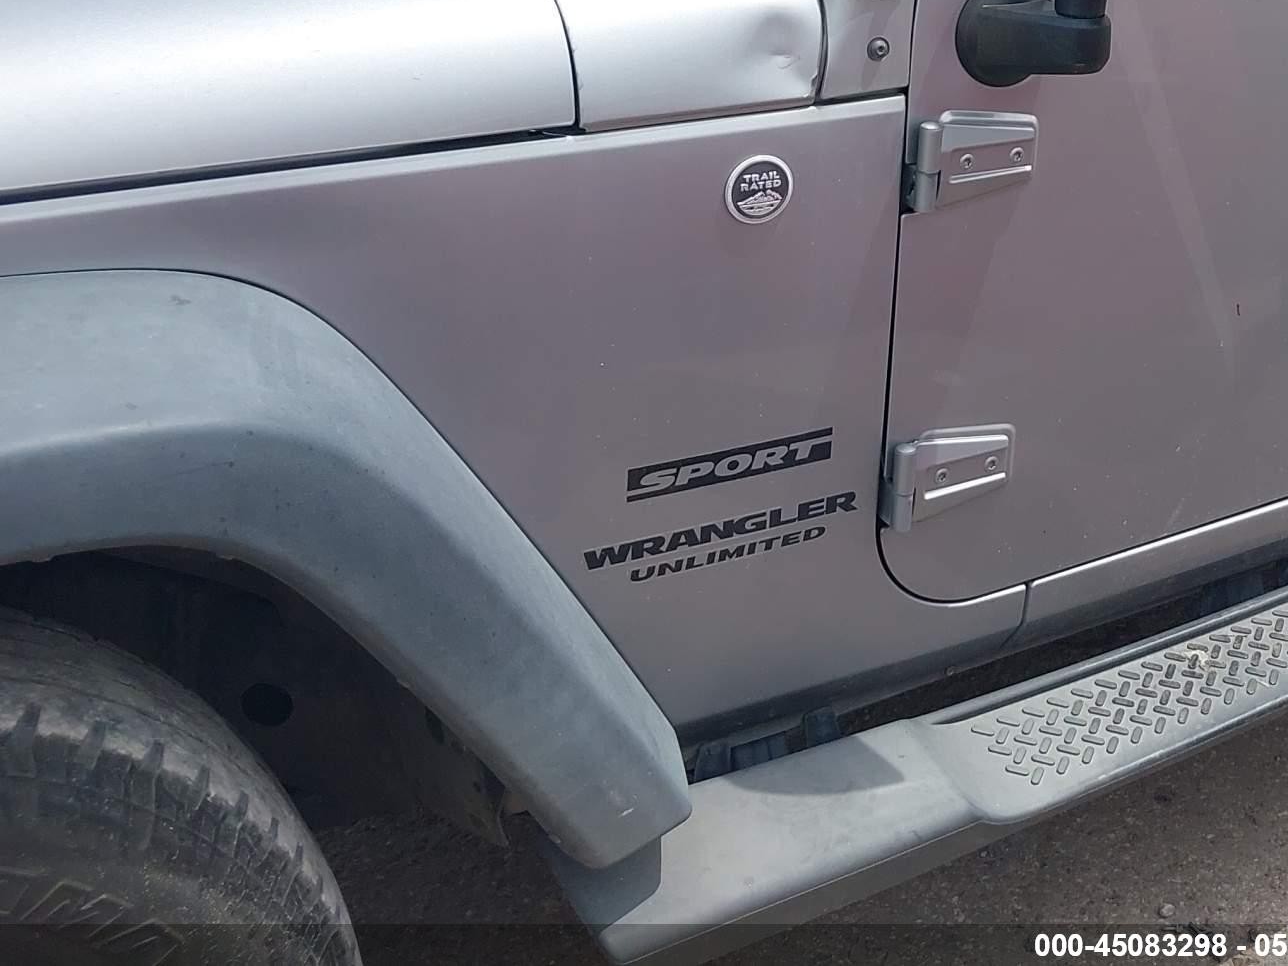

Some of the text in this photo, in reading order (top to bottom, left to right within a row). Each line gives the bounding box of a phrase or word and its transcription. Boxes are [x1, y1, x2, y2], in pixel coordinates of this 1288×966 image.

[740, 179, 782, 192] RATED
[743, 170, 780, 182] TRAIL
[639, 440, 824, 492] SPORT
[583, 490, 859, 571] WRANGLER
[630, 525, 827, 583] UNLIMITED
